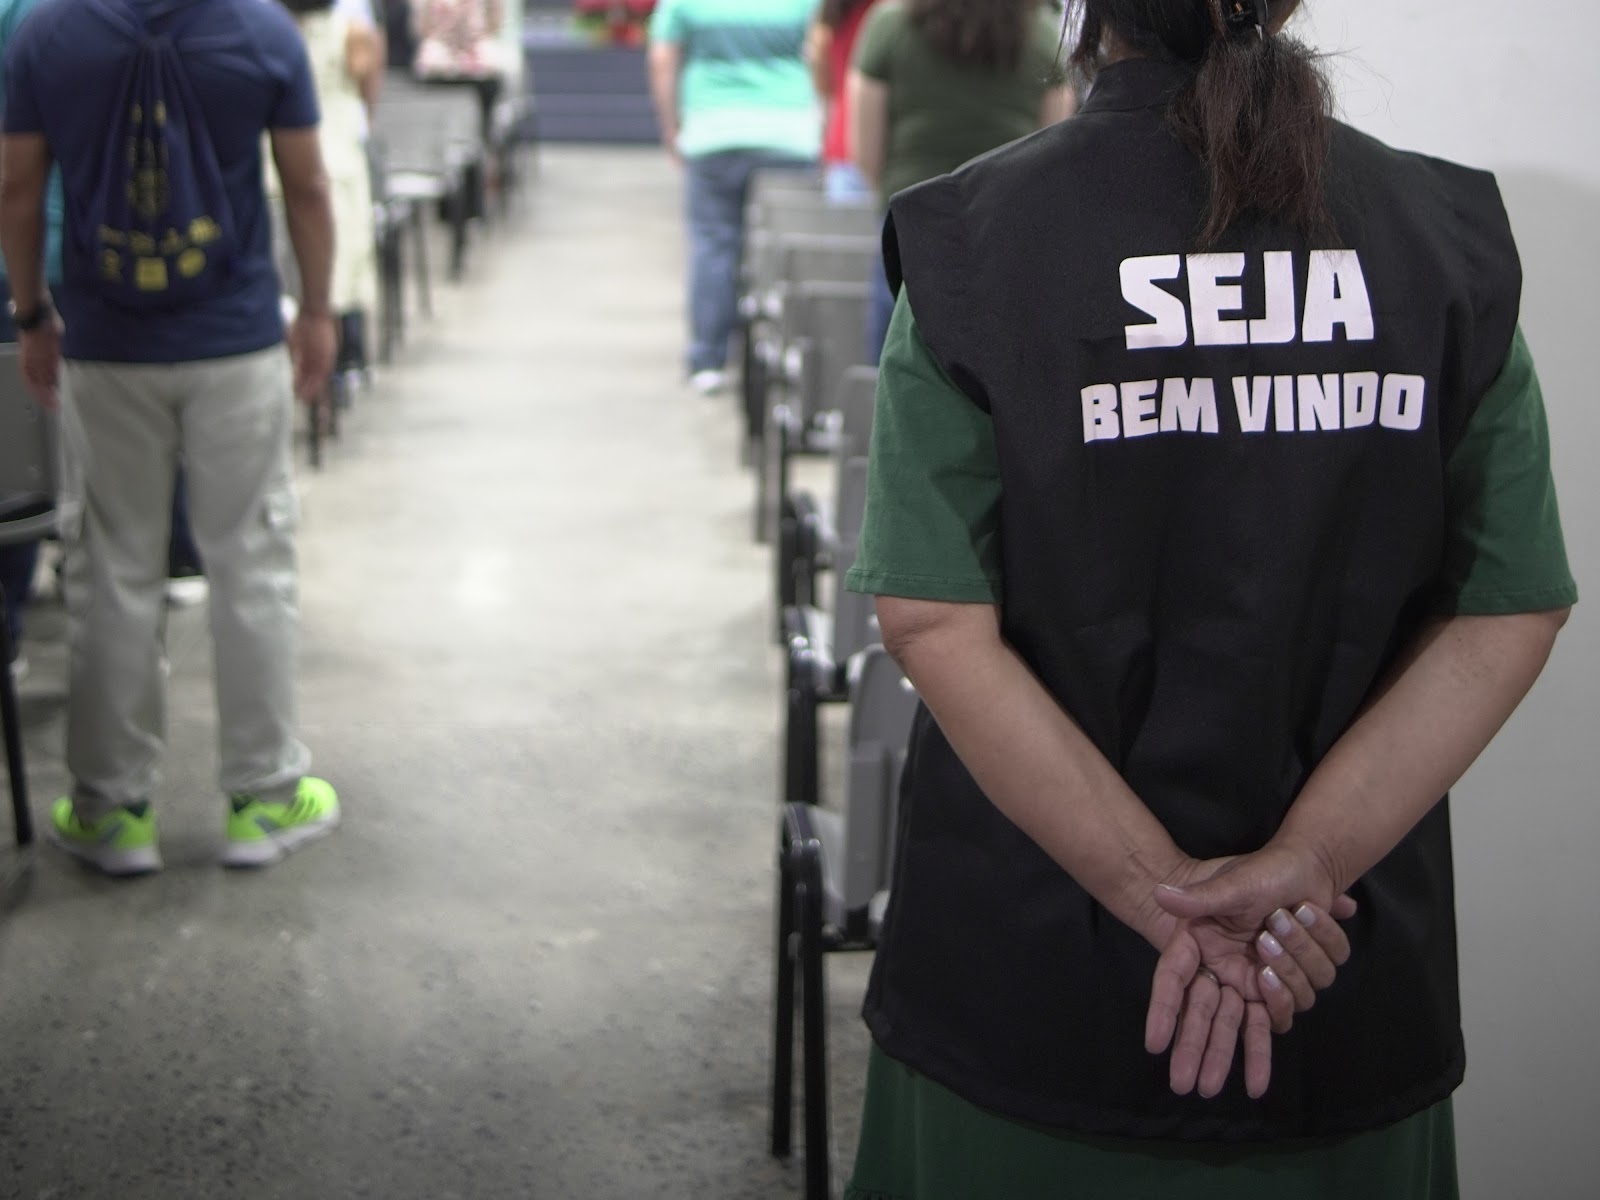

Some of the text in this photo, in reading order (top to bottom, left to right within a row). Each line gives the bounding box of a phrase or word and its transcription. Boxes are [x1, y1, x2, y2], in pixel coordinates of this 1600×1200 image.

[1119, 249, 1374, 350] SEJA
[1080, 371, 1425, 443] BEM VINDO
